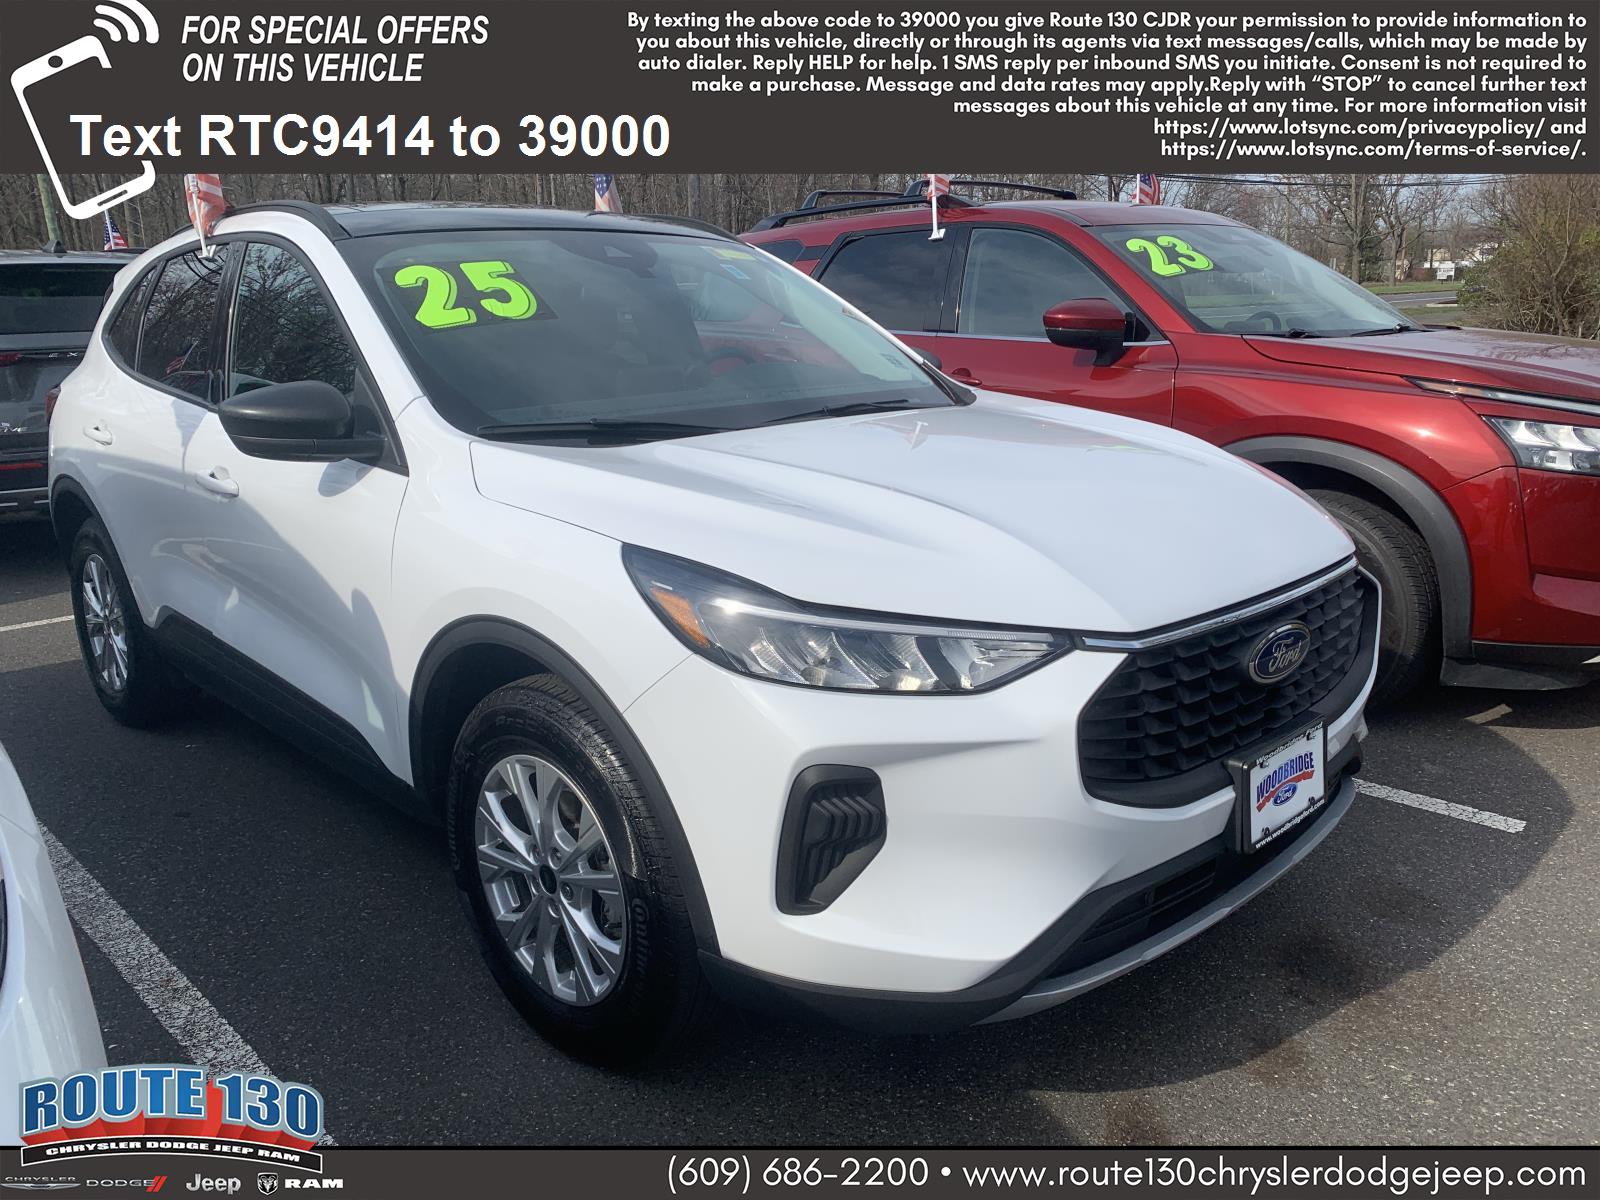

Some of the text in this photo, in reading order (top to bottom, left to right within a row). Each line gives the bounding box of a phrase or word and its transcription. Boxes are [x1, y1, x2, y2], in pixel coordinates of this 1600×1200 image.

[1126, 236, 1213, 277] 23
[395, 261, 538, 329] 25
[1269, 637, 1301, 672] Ford
[1256, 752, 1315, 804] WOODBRIDGE
